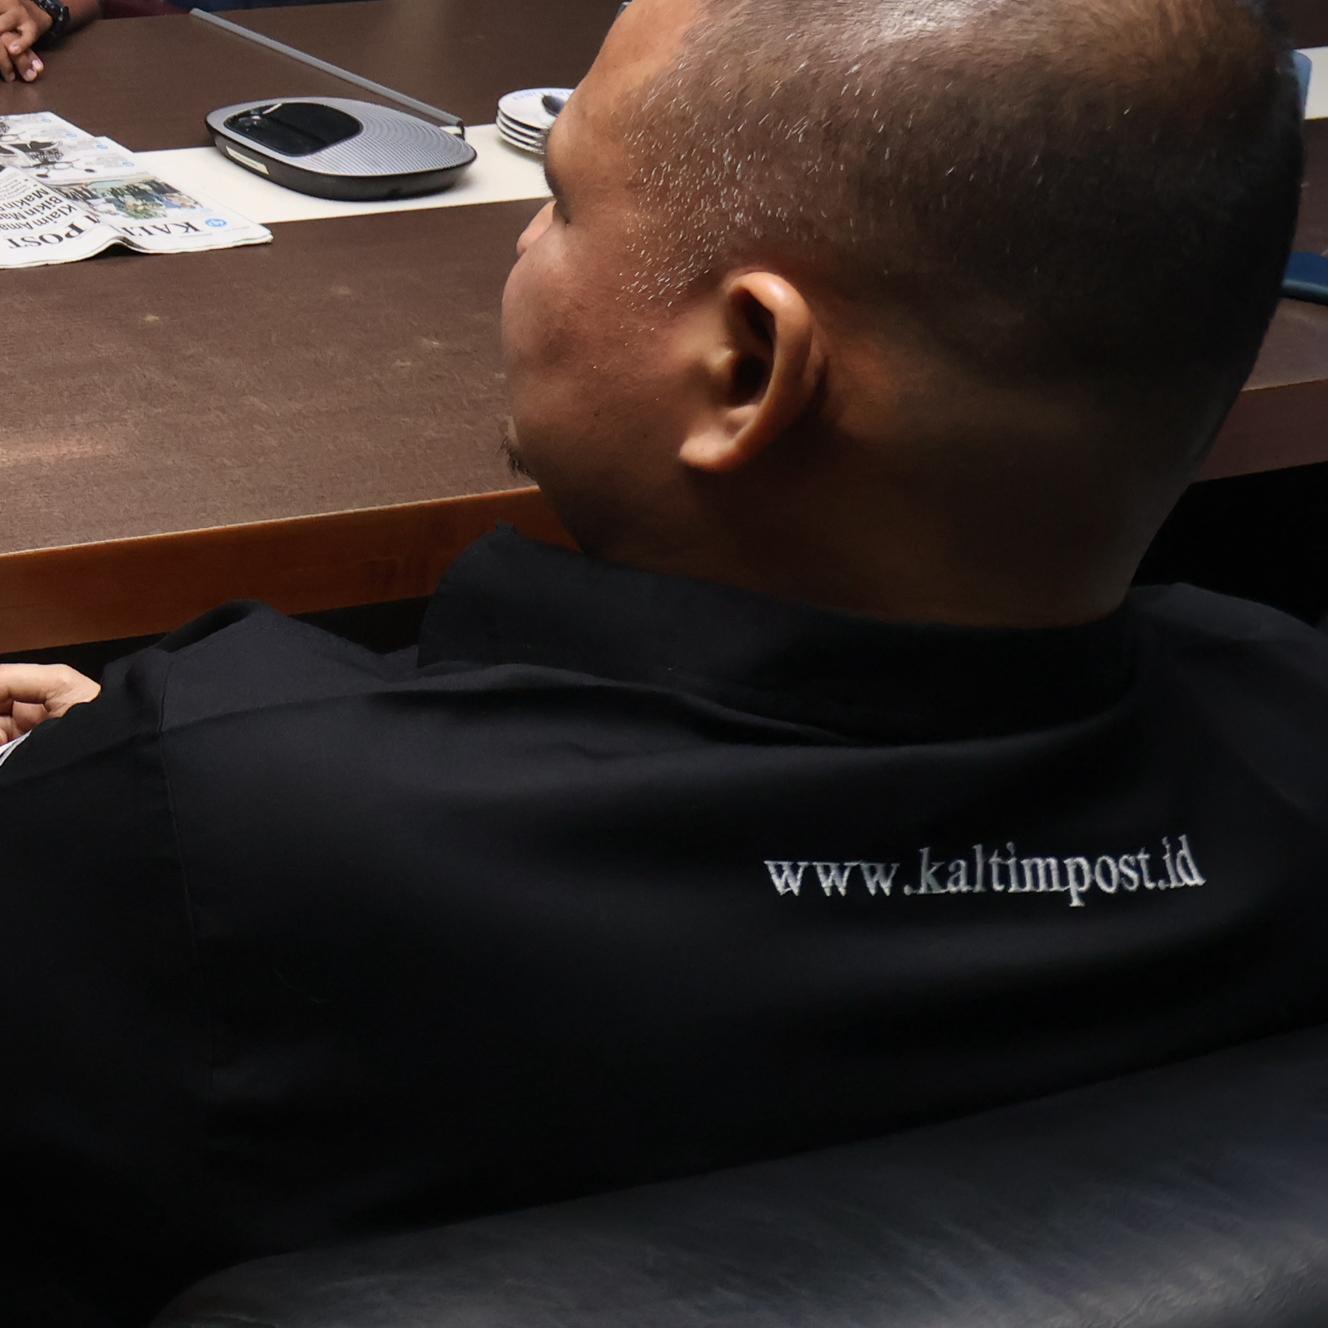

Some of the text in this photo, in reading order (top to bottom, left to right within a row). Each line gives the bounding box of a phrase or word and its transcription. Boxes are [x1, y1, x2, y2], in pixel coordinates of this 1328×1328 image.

[4, 187, 50, 210] Makin
[24, 195, 61, 218] Bikin
[32, 203, 75, 227] Klaim
[6, 222, 87, 249] POST
[763, 834, 1207, 907] www.kaltimpost.id
